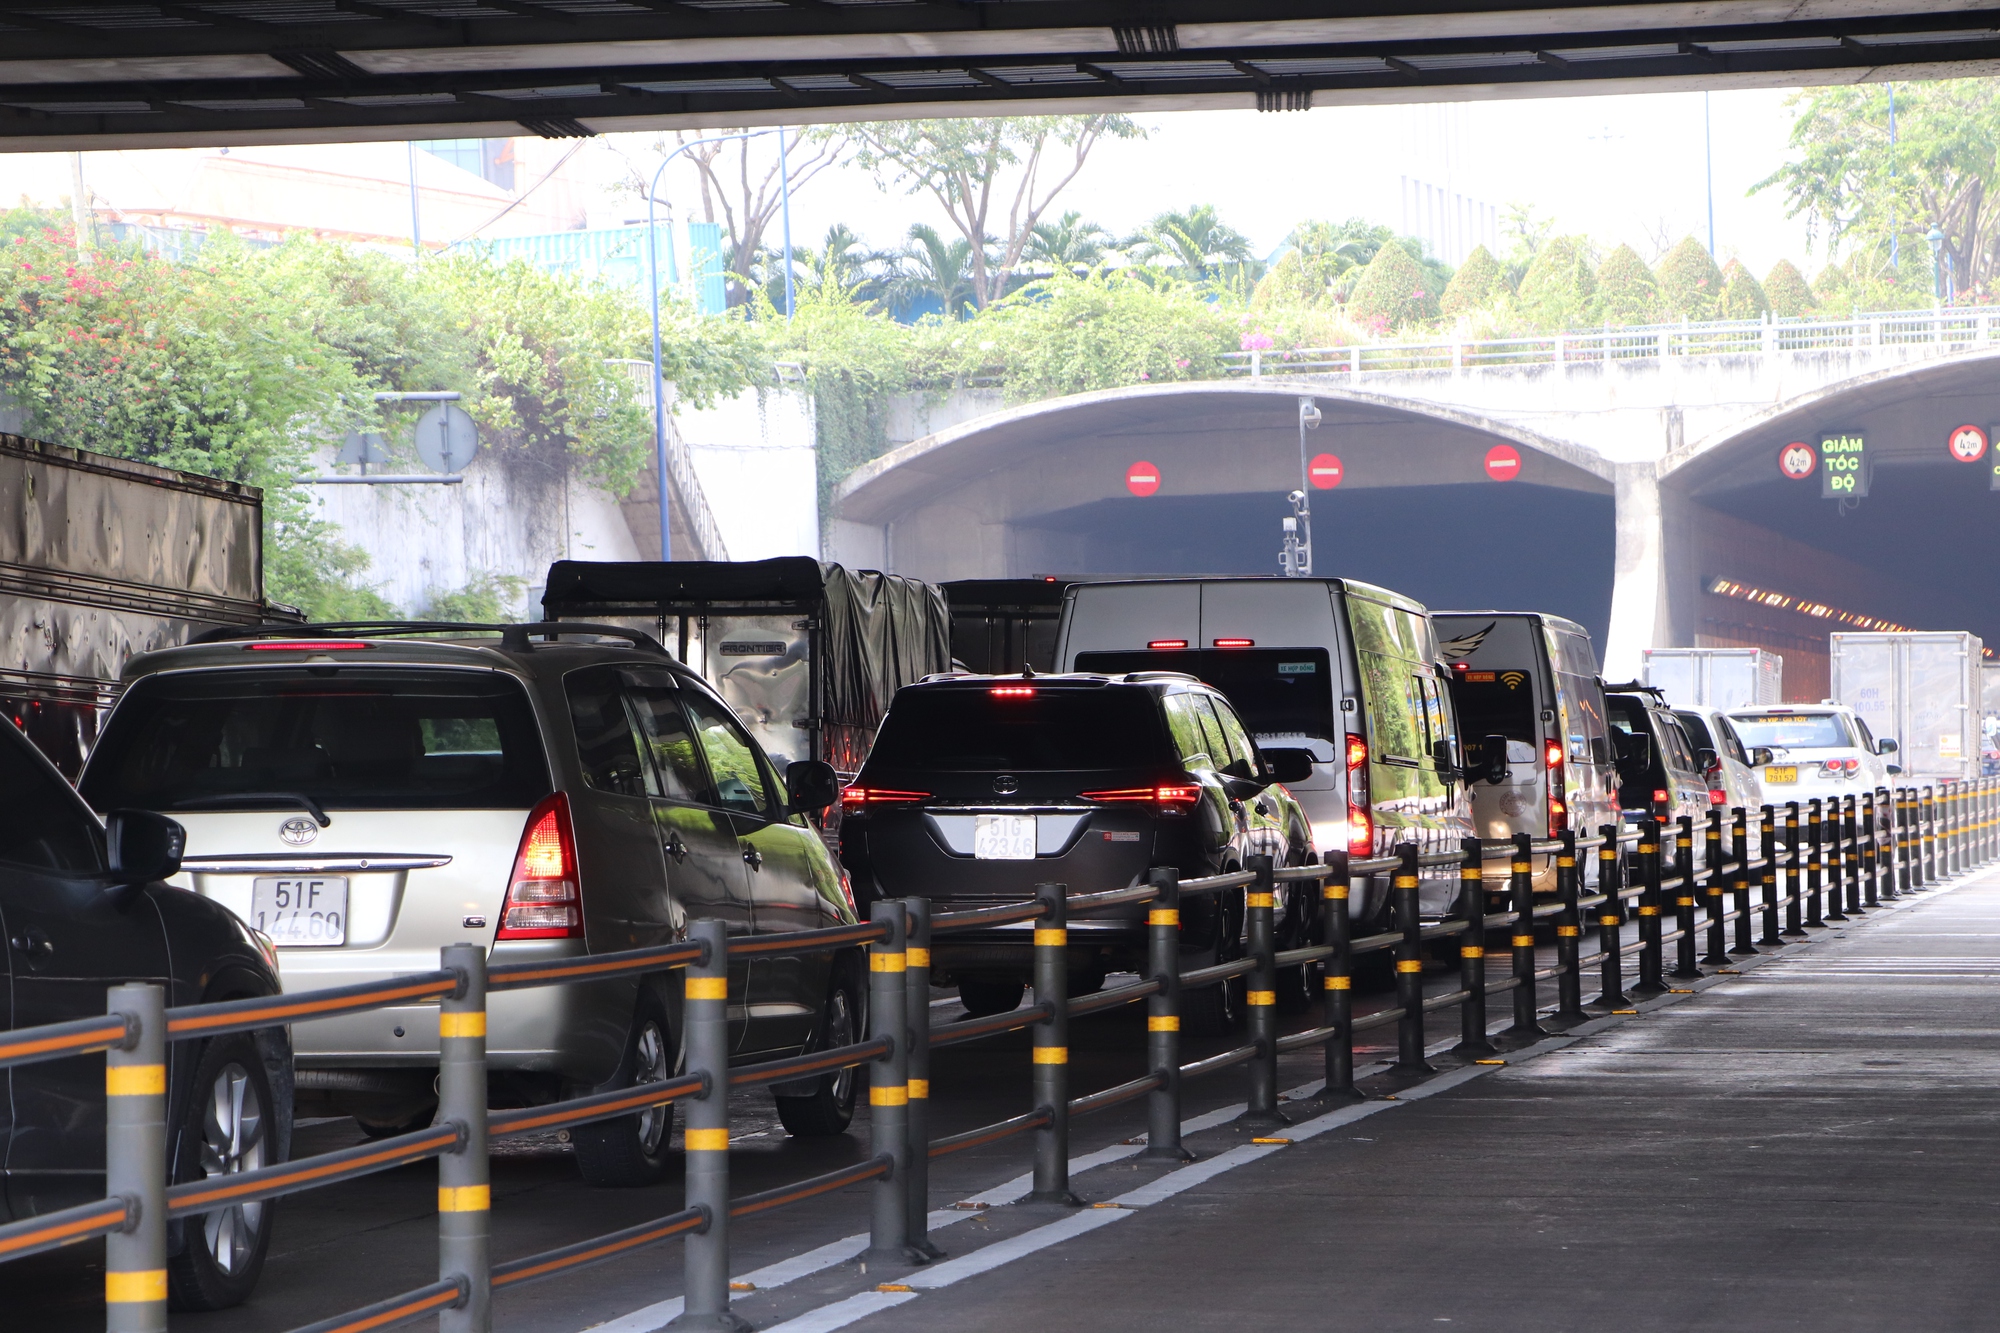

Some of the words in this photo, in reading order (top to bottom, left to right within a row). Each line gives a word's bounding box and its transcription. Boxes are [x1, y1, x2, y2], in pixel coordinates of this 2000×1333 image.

[1822, 435, 1863, 453] GIẢM
[1831, 473, 1855, 492] ĐỘ
[722, 644, 783, 653] FRONTIER
[1860, 688, 1879, 699] 60H
[1853, 701, 1885, 712] 100.55
[990, 818, 1021, 837] 51G
[978, 837, 1033, 856] 423.46
[275, 881, 324, 909] 51F
[257, 911, 340, 939] 144.60
